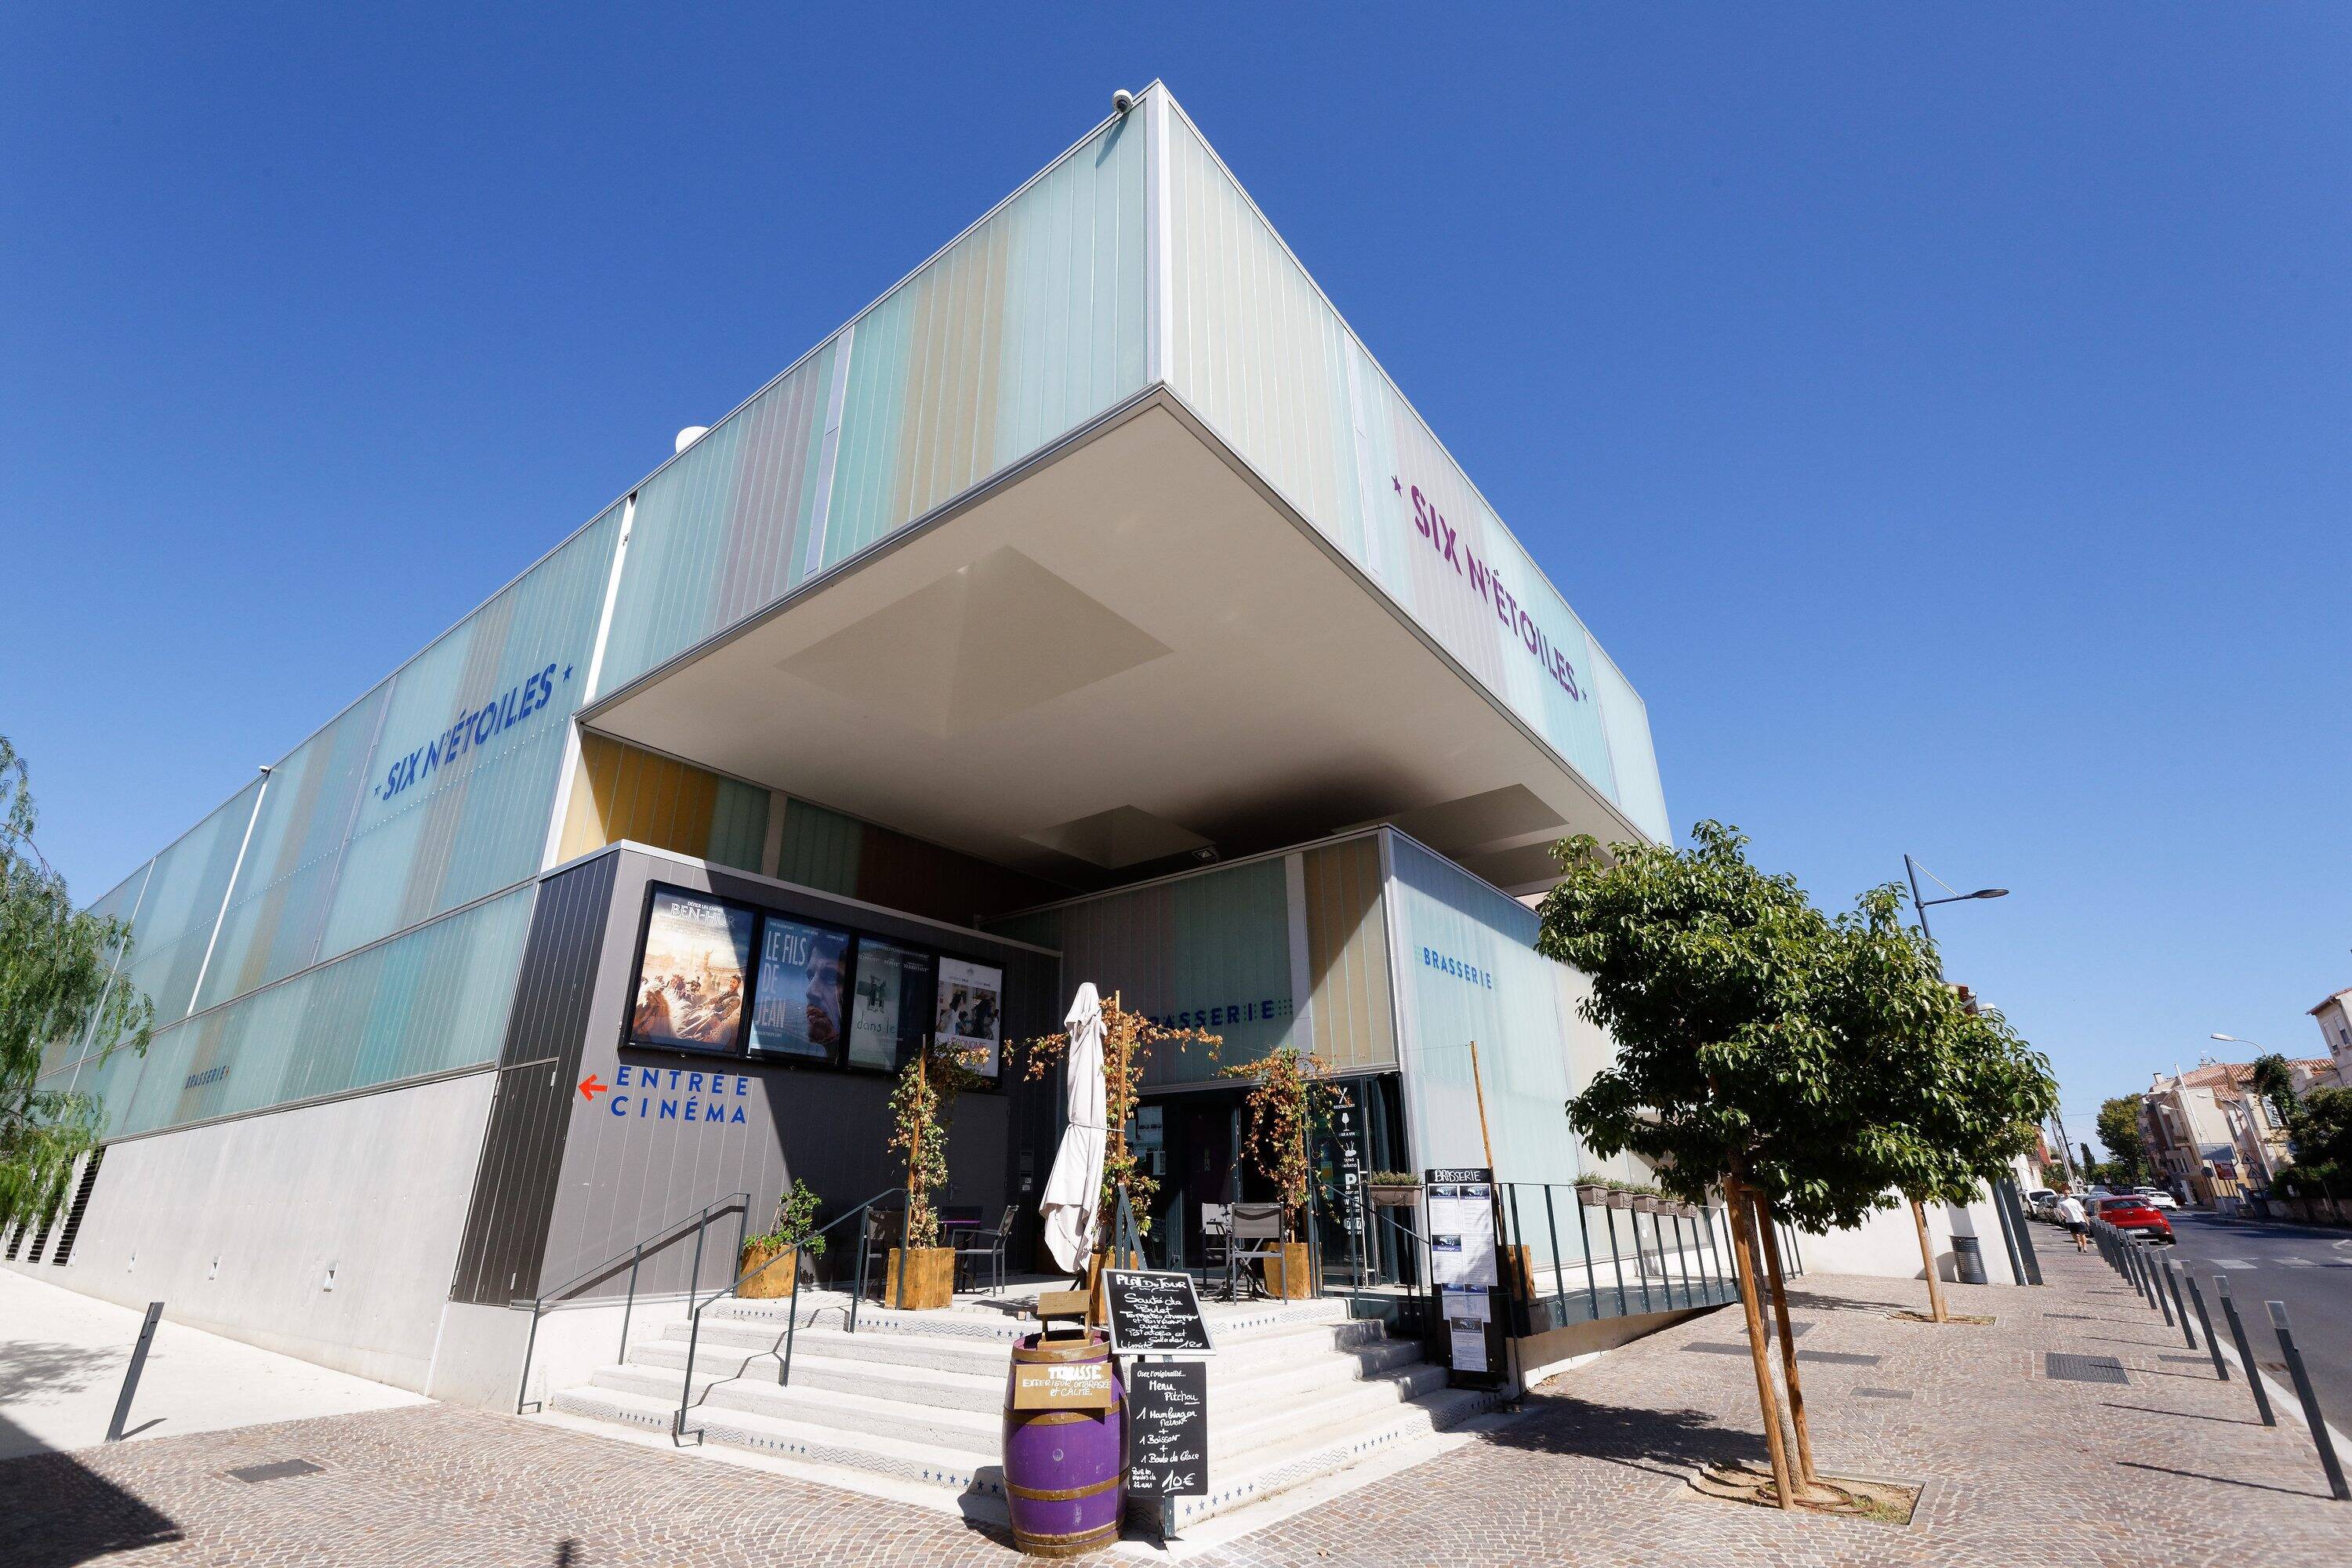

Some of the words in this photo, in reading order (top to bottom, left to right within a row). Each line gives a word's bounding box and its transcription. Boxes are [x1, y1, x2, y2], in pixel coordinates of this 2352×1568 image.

[1411, 485, 1462, 576] SIX
[383, 746, 424, 801] SIX
[670, 902, 735, 927] BEN-HUR
[765, 931, 781, 962] LE
[782, 935, 807, 967] FILS
[762, 963, 779, 994] DE
[1424, 946, 1492, 989] BRASSERIE
[755, 996, 786, 1028] JEAN
[856, 1010, 882, 1033] dans
[184, 1065, 227, 1090] BRASSERIE
[616, 1065, 749, 1096] ENTRÉE
[611, 1095, 746, 1124] CINÉMA
[1434, 1169, 1481, 1182] BRASSERIE
[1116, 1274, 1145, 1287] PLAT
[1124, 1293, 1164, 1305] Sauté
[1164, 1297, 1184, 1306] de
[1133, 1304, 1174, 1316] Poulet
[1149, 1380, 1176, 1391] Menu
[1163, 1391, 1199, 1402] Pitchou
[1136, 1406, 1146, 1420] 1
[1149, 1406, 1198, 1420] Hamburger
[1139, 1436, 1145, 1446] 1
[1141, 1455, 1147, 1464] 1
[1180, 1450, 1200, 1462] Glace
[1161, 1469, 1196, 1489] 10€
